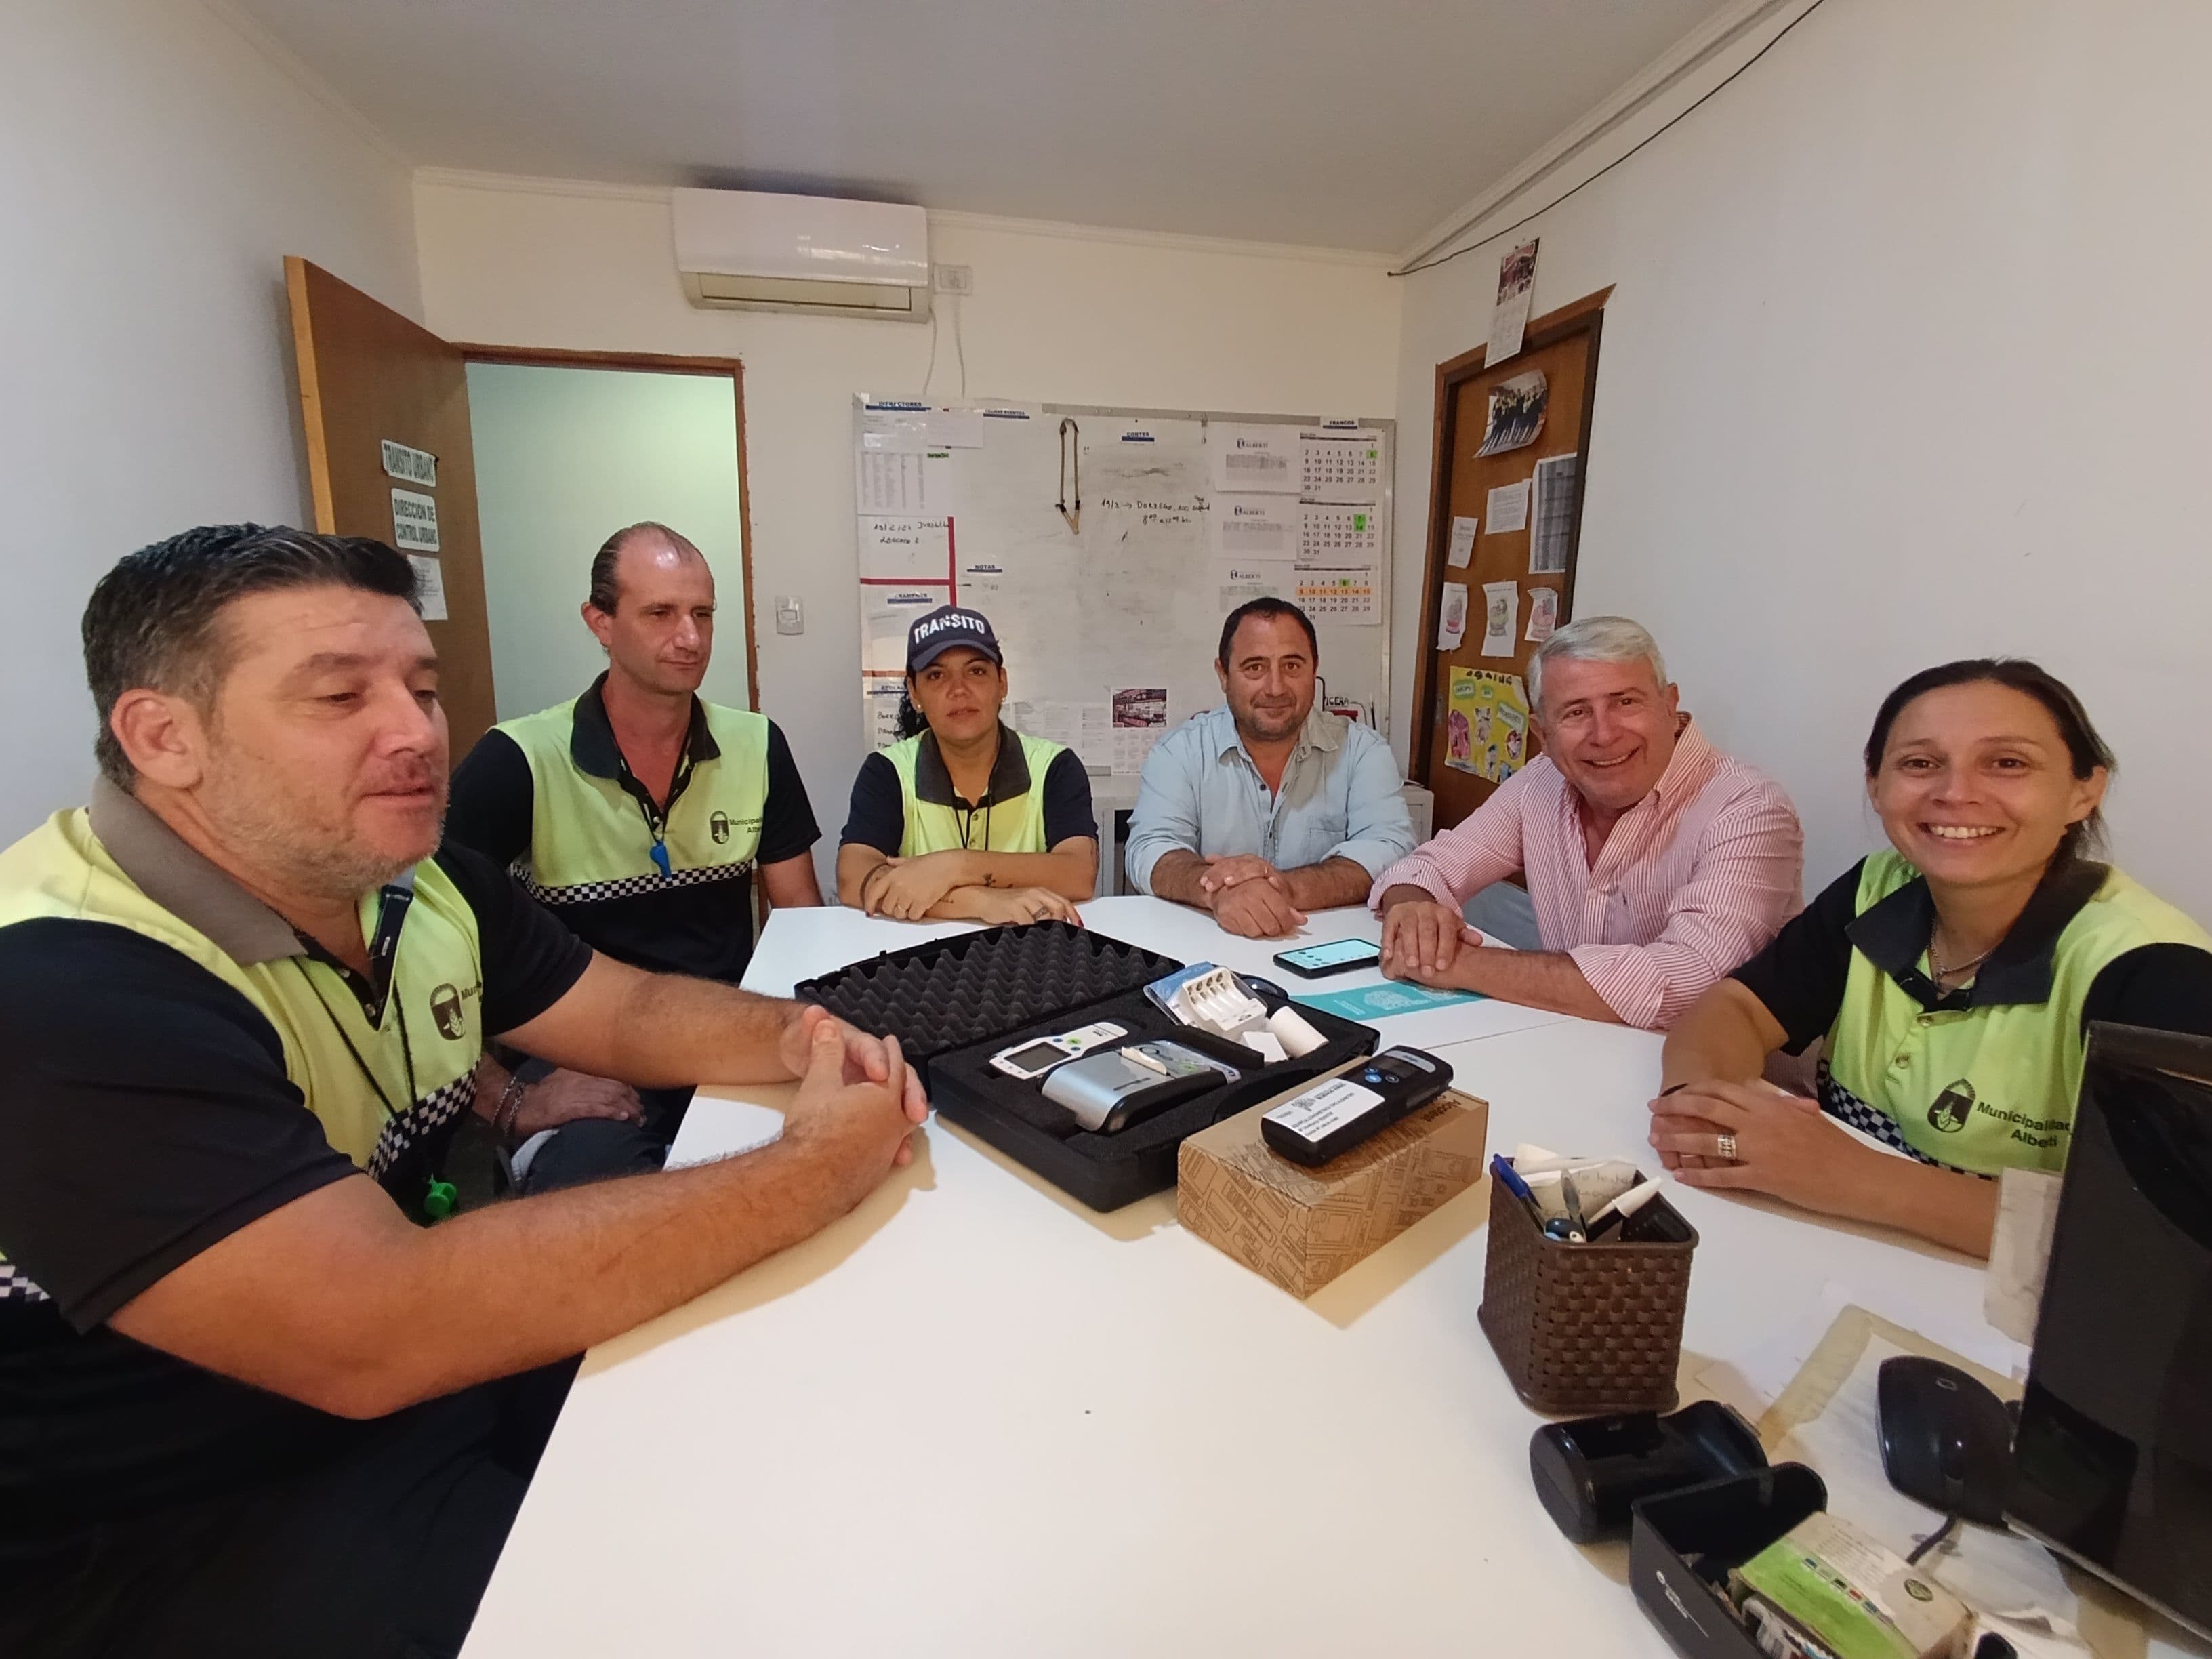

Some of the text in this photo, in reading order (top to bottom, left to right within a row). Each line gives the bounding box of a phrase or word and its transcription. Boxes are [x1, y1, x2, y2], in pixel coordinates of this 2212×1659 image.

[427, 506, 435, 522] DE
[914, 613, 985, 644] TRANSITO
[2011, 1129, 2057, 1148] Albeti
